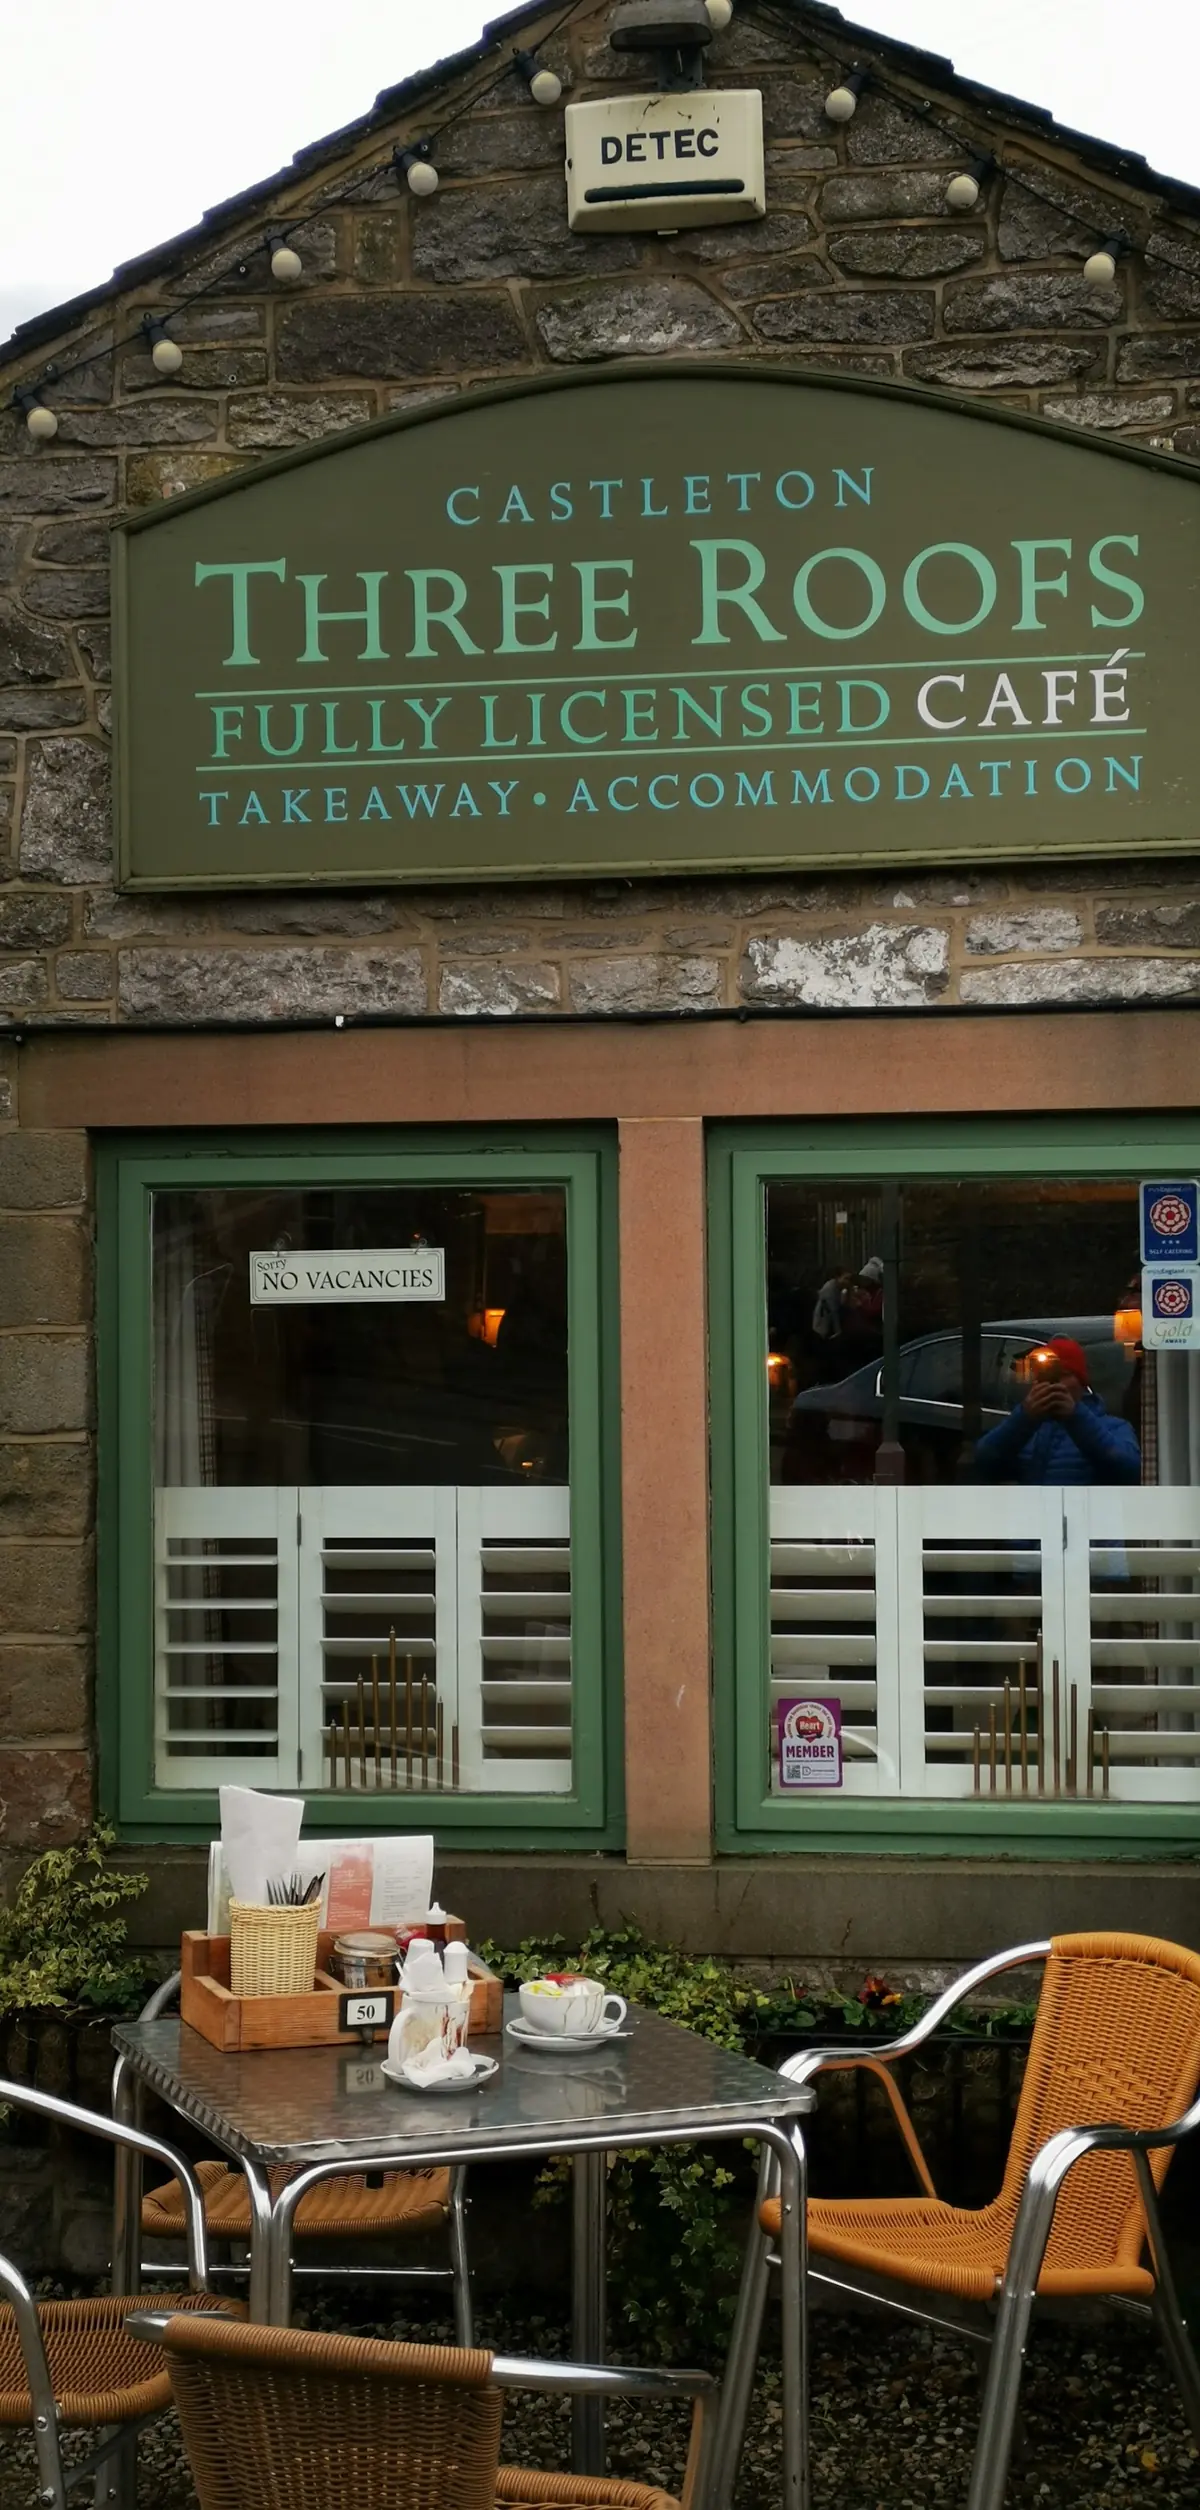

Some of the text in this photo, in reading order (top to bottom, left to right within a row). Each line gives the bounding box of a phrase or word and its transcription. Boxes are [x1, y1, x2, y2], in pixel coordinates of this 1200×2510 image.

[601, 128, 719, 165] DETEC
[446, 467, 874, 525] CASTLETON
[195, 534, 1145, 666] THREE ROOFS
[210, 648, 1130, 758] FULLY LICENSED CAFÉ
[199, 755, 1143, 826] TAKEAWAY ACCOMMODATION
[257, 1258, 287, 1272] Sorry
[262, 1268, 433, 1290] NO VACANCIES
[786, 1745, 834, 1758] MEMBER
[356, 2005, 375, 2020] 50
